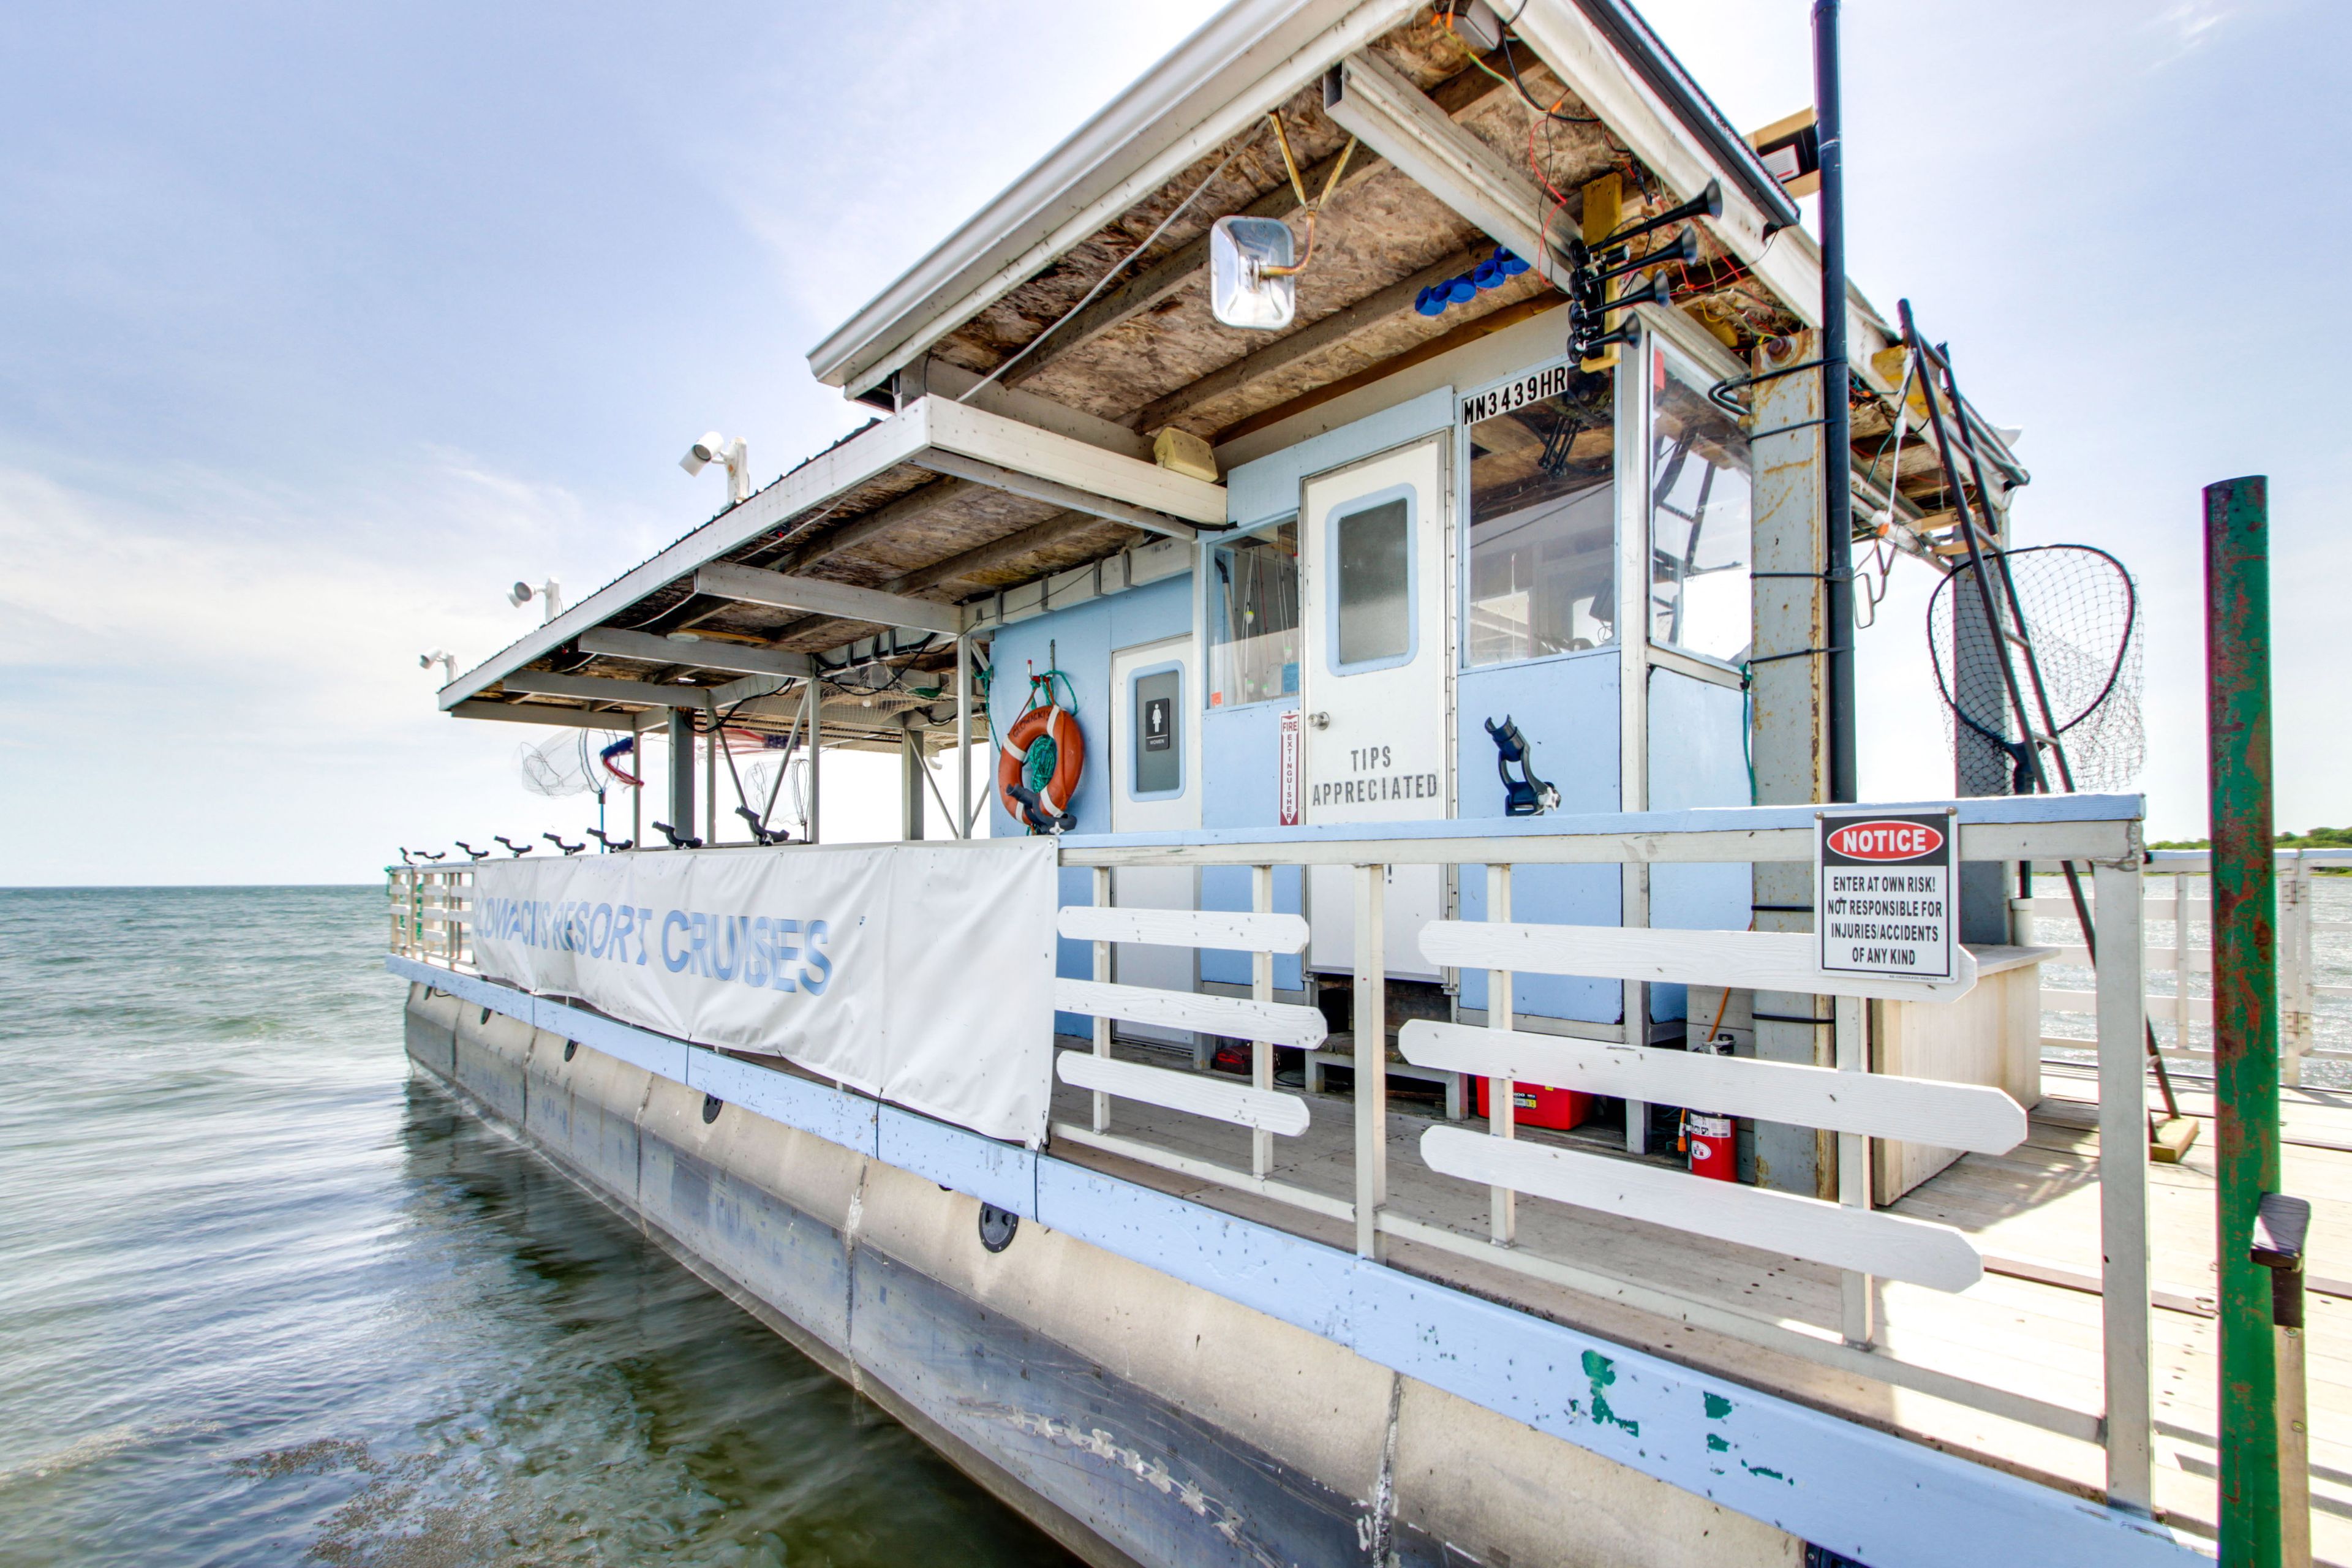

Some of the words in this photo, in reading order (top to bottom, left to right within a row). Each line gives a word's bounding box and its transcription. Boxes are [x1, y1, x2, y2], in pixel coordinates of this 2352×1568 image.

[1464, 366, 1566, 425] MN3439HR
[1283, 721, 1297, 732] FIRE
[1351, 746, 1391, 772] TIPS
[1313, 774, 1437, 806] APPRECIATED
[1843, 829, 1926, 852] NOTICE
[1833, 876, 1864, 892] ENTER
[1867, 876, 1880, 892] AT
[1882, 876, 1904, 892] OWN
[1907, 876, 1936, 892] RISK!
[1828, 899, 1847, 914] NOT
[1850, 900, 1918, 916] RESPONSIBLE
[1921, 901, 1942, 918] FOR
[1831, 922, 1939, 941] INJURIES/ACCIDENTS
[553, 901, 653, 966] RESORT
[661, 910, 832, 996] CRUISES
[1852, 947, 1864, 962] OF
[1867, 948, 1888, 964] ANY
[1890, 949, 1915, 965] KIND
